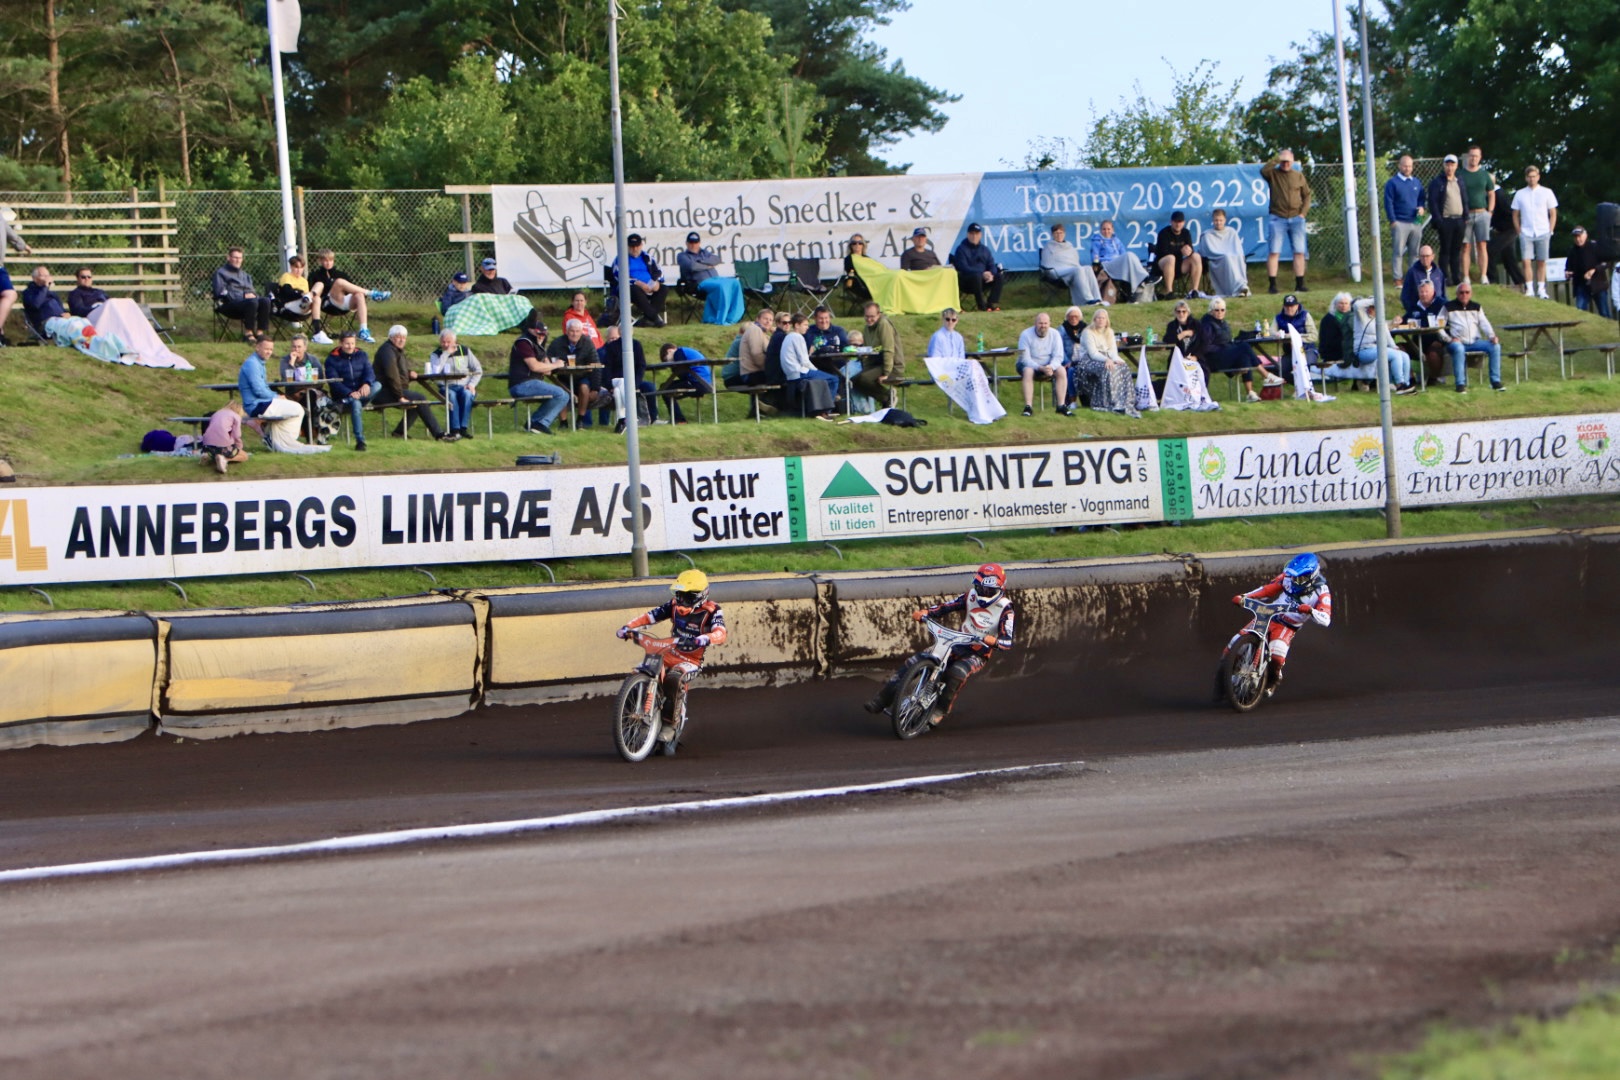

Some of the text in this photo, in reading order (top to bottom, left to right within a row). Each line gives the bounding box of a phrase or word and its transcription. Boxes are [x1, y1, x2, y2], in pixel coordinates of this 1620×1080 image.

[580, 195, 756, 238] Nymindegab
[767, 192, 877, 225] Snedker
[909, 193, 932, 219] &
[1015, 178, 1271, 221] Tommy 20 28 22 8
[982, 221, 1052, 253] Male
[1126, 220, 1159, 249] 23
[1449, 421, 1568, 466] Lunde
[1576, 423, 1608, 433] KLOAK-
[1578, 431, 1608, 441] MESTER
[884, 451, 1054, 497] SCHANTZ
[1062, 446, 1133, 487] BYG
[1174, 442, 1187, 516] Telefon
[1233, 436, 1342, 480] Lunde
[1407, 456, 1620, 499] Entreprenør A/S
[668, 467, 760, 504] Natur
[786, 461, 800, 539] Telefon
[65, 482, 652, 560] ANNEBERGS LIMTRÆ A/S
[692, 503, 784, 543] Suiter
[827, 501, 875, 516] Kvalitet
[829, 519, 876, 532] til tiden
[887, 507, 970, 526] Entreprenør
[982, 502, 1068, 519] Kloakmester
[1079, 494, 1150, 516] Vognmand
